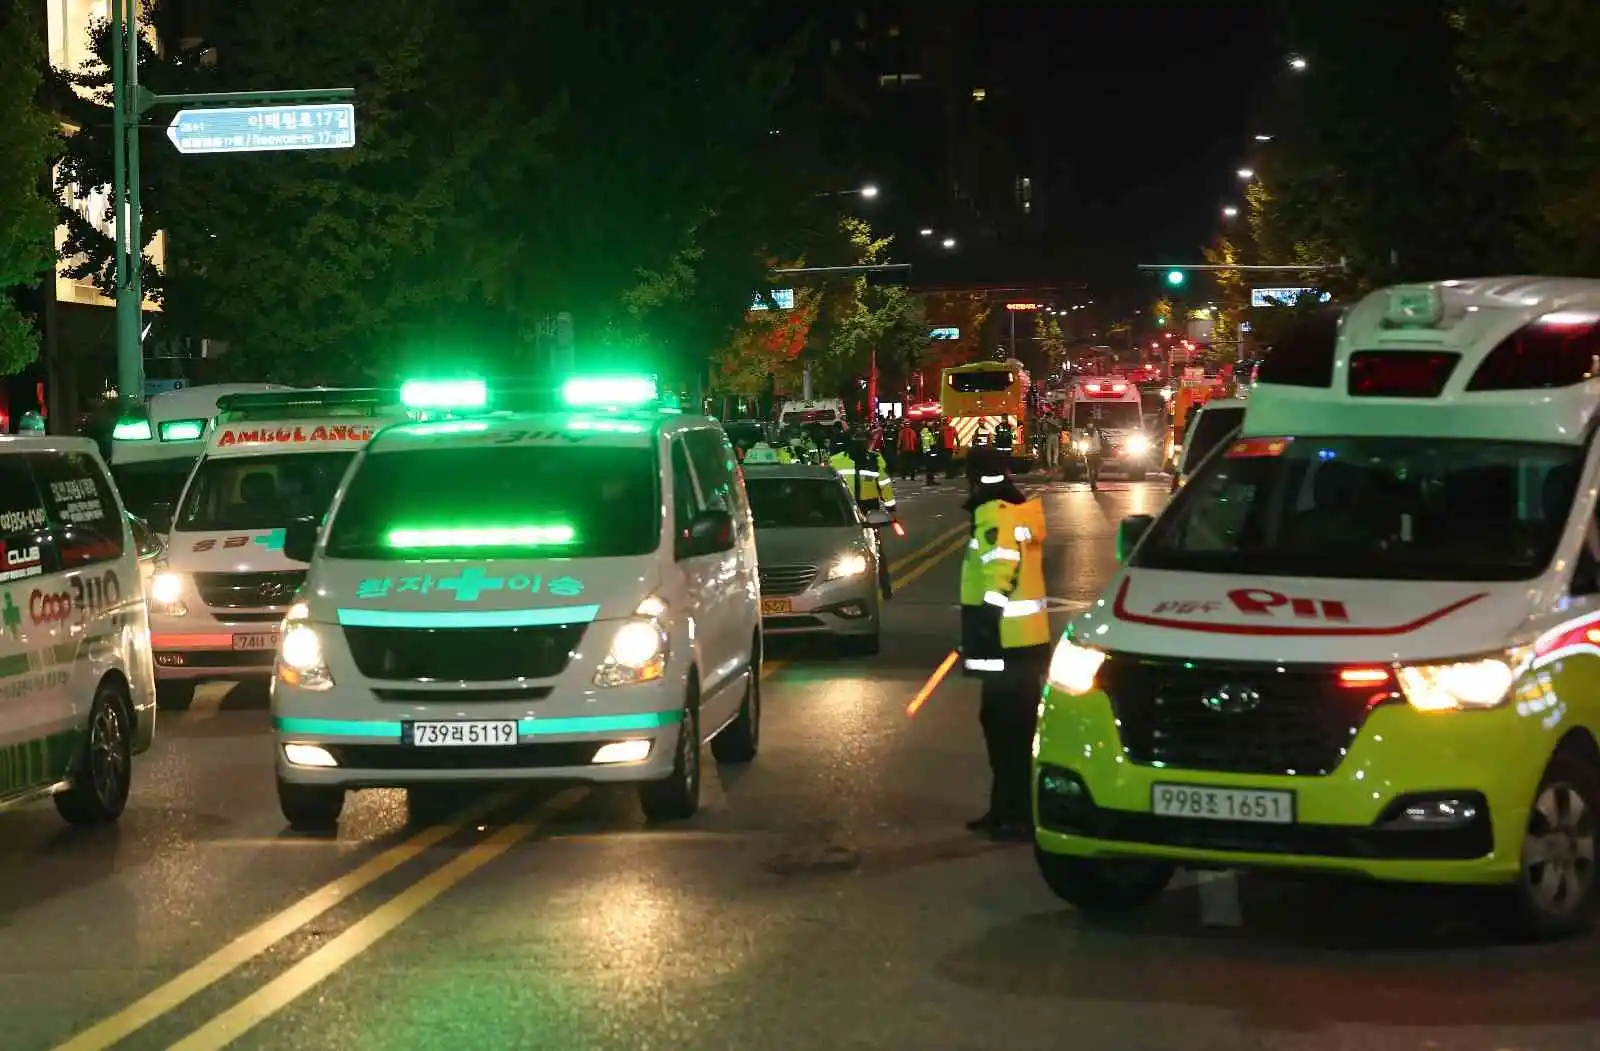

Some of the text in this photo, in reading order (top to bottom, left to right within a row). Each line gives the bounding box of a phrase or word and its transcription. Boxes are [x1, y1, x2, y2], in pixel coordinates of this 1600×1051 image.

[7, 545, 41, 565] CLUB
[468, 723, 513, 743] 5119
[1225, 794, 1281, 818] 1651
